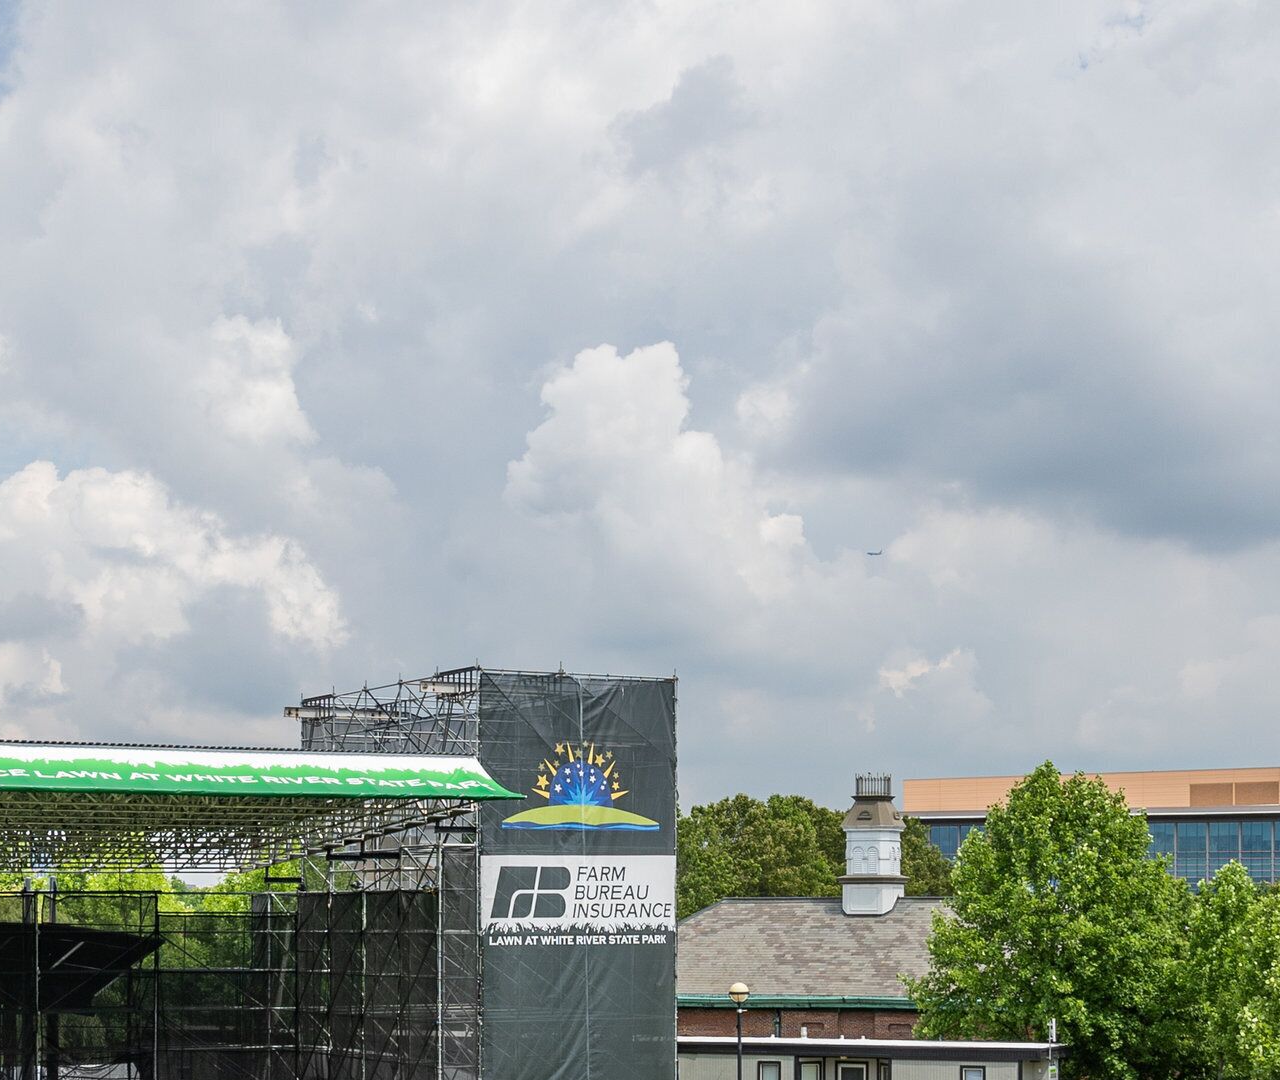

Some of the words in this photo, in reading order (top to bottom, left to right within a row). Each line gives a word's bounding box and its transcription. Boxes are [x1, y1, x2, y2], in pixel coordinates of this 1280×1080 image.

[33, 770, 123, 780] LAWN
[130, 772, 161, 782] AT
[164, 773, 259, 784] WHITE
[260, 775, 343, 785] RIVER
[345, 777, 428, 788] STATE
[576, 866, 627, 881] FARM
[574, 884, 650, 900] BUREAU
[572, 902, 672, 918] INSURANCE
[489, 936, 522, 946] LAWN
[524, 936, 539, 945] AT
[540, 935, 575, 945] WHITE
[576, 935, 607, 945] RIVER
[608, 935, 640, 945] STATE
[642, 934, 667, 944] PARK
